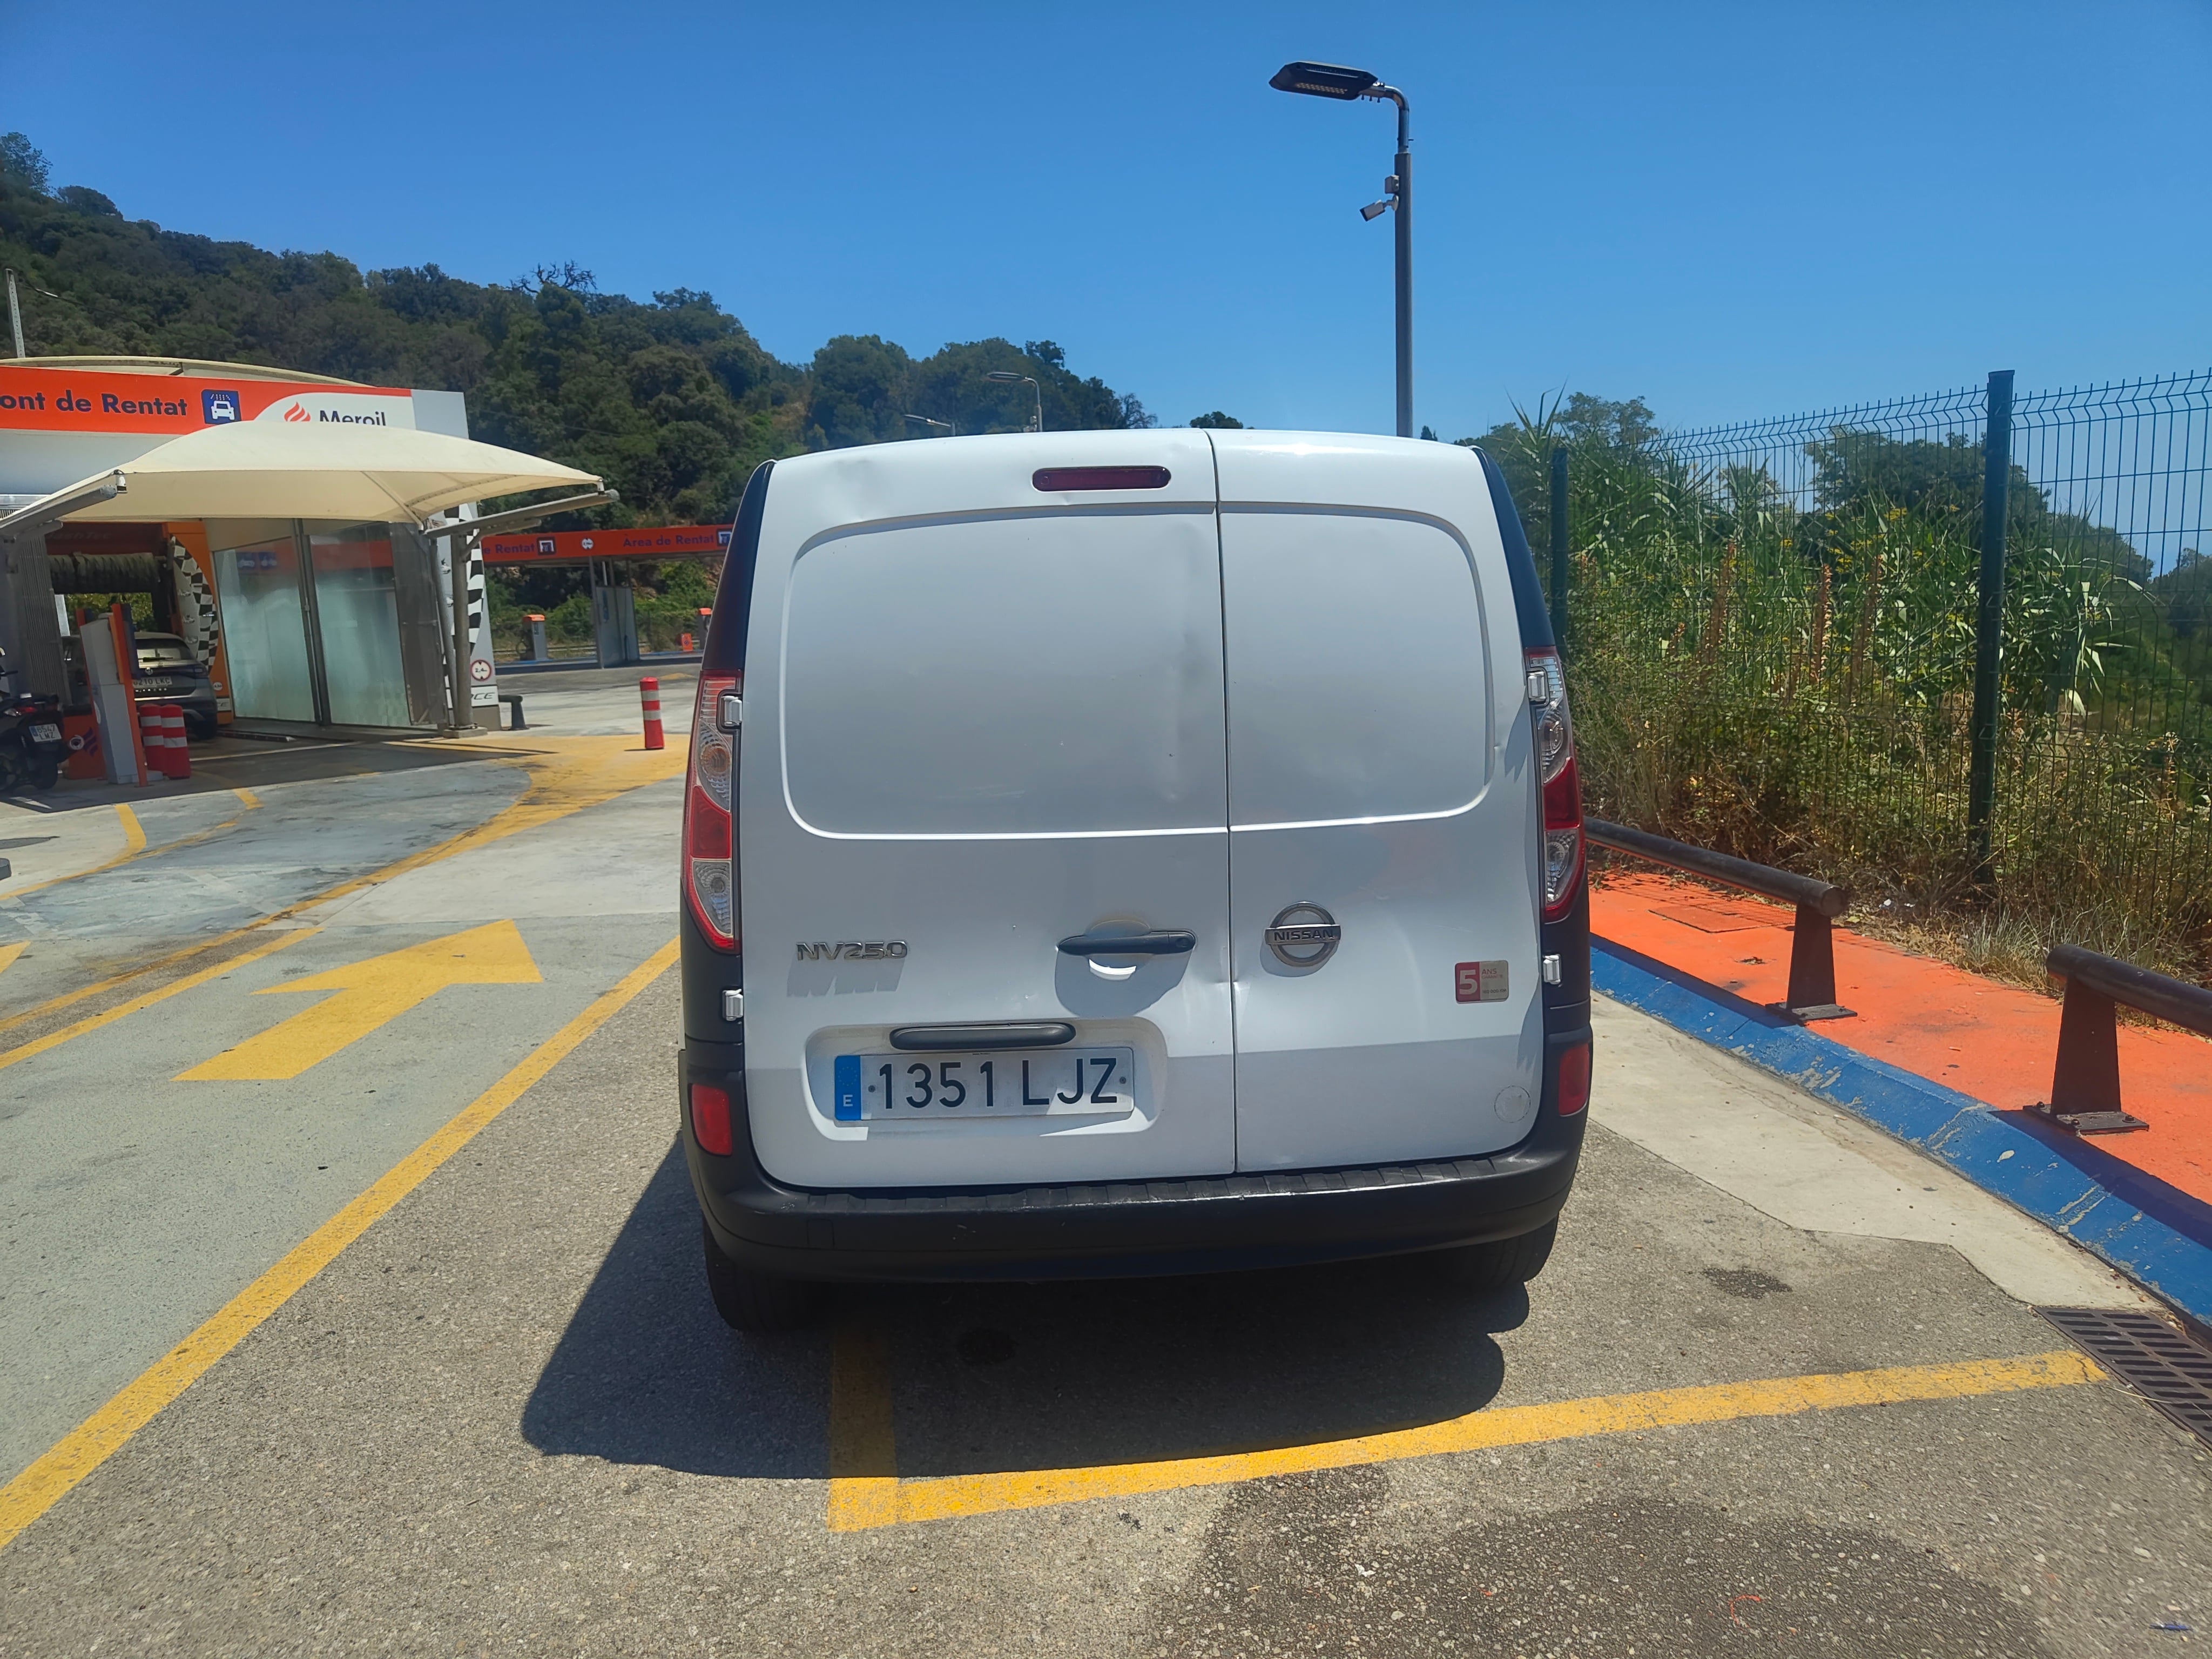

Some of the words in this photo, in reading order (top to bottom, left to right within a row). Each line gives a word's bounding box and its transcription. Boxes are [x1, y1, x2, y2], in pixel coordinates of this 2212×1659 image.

[56, 389, 92, 412] de
[101, 393, 187, 416] Rentat
[656, 535, 671, 545] de
[676, 534, 714, 545] Rentat
[495, 543, 535, 554] Rentat
[39, 732, 56, 740] LMZ
[1273, 929, 1334, 941] NISSAN
[796, 941, 908, 961] NV250
[1459, 969, 1478, 995] 5
[879, 1060, 995, 1109] 1351
[1022, 1057, 1118, 1106] LJZ
[842, 1094, 853, 1107] E
